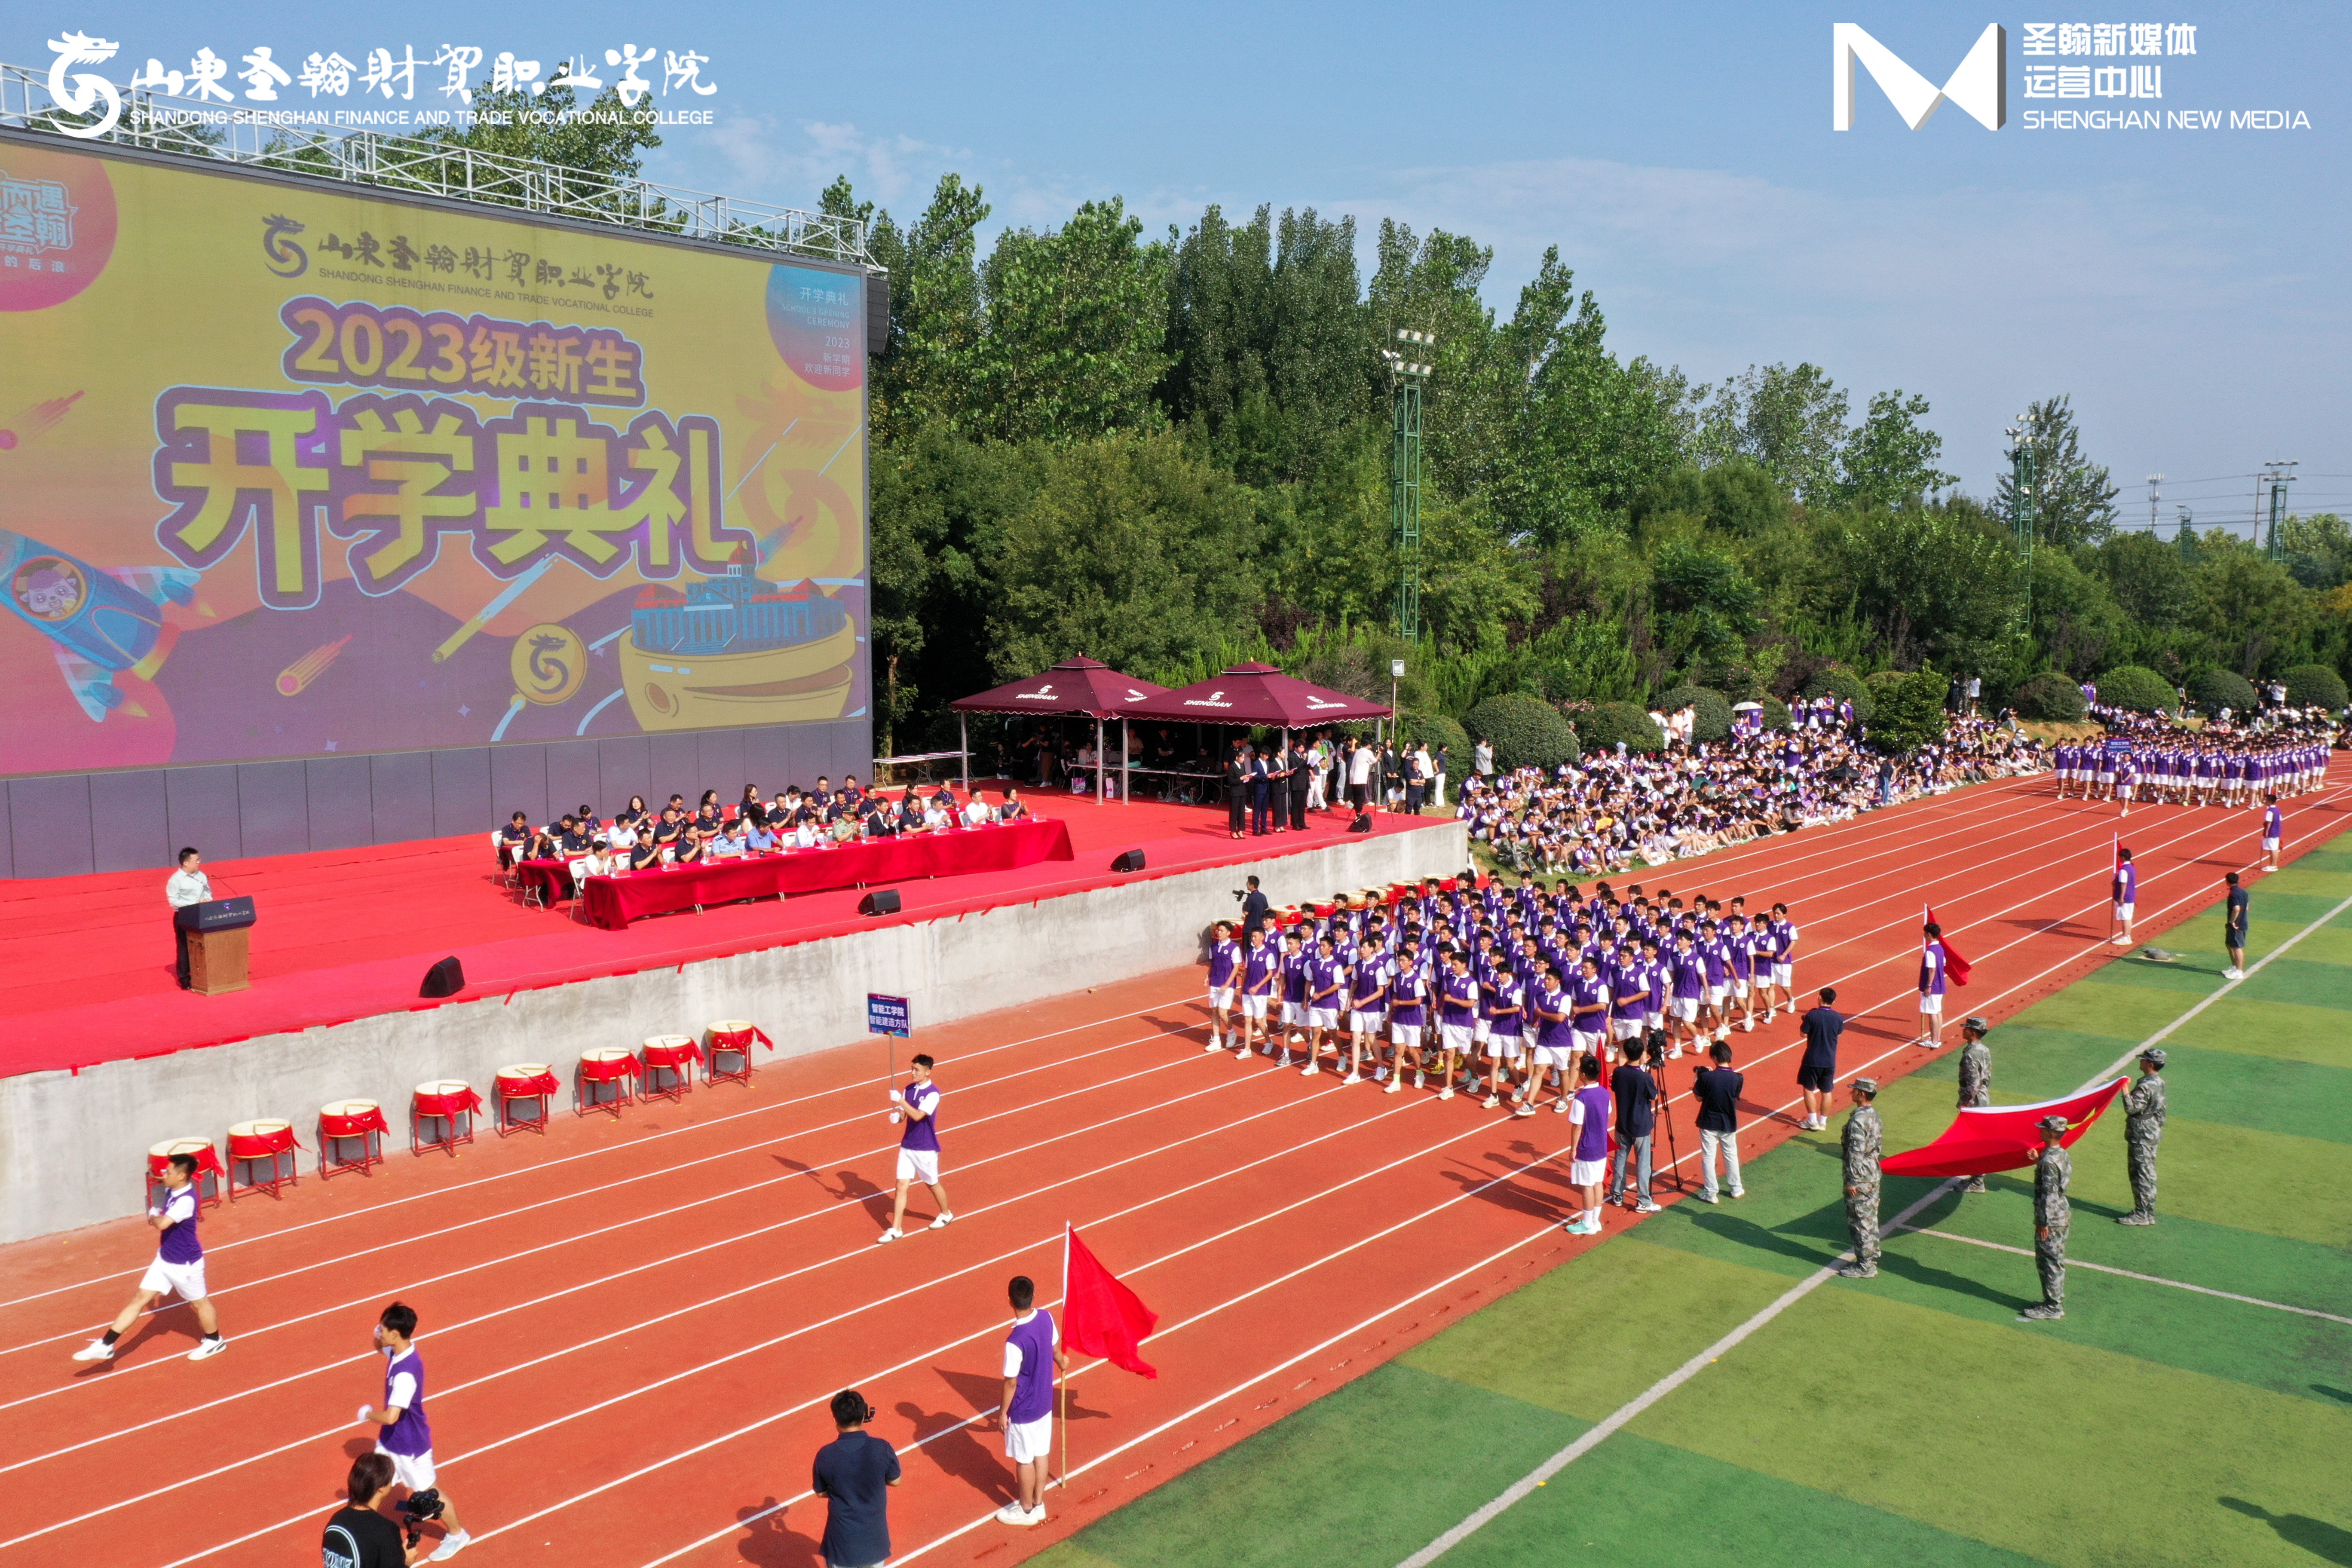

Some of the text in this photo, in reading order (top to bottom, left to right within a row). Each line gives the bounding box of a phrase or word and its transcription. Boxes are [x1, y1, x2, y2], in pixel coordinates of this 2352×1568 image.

[0, 181, 68, 215] 而遇
[0, 213, 68, 247] 圣翰
[319, 268, 654, 318] SHANDONG SHENGHAN FINANCE AND TRADE VOCATIONAL COLLEGE
[800, 286, 849, 306] 开学典礼
[782, 303, 850, 319] SCHOOL'S OPENING
[807, 316, 850, 328] CEREMONY
[825, 335, 850, 349] 2023
[291, 306, 638, 400] 2023级新生
[823, 352, 850, 365] 新学期
[804, 363, 851, 377] 欢迎新同学
[168, 400, 750, 595] 开学典礼
[871, 1003, 905, 1017] 智能工学院
[869, 1014, 908, 1029] 智能建造方队
